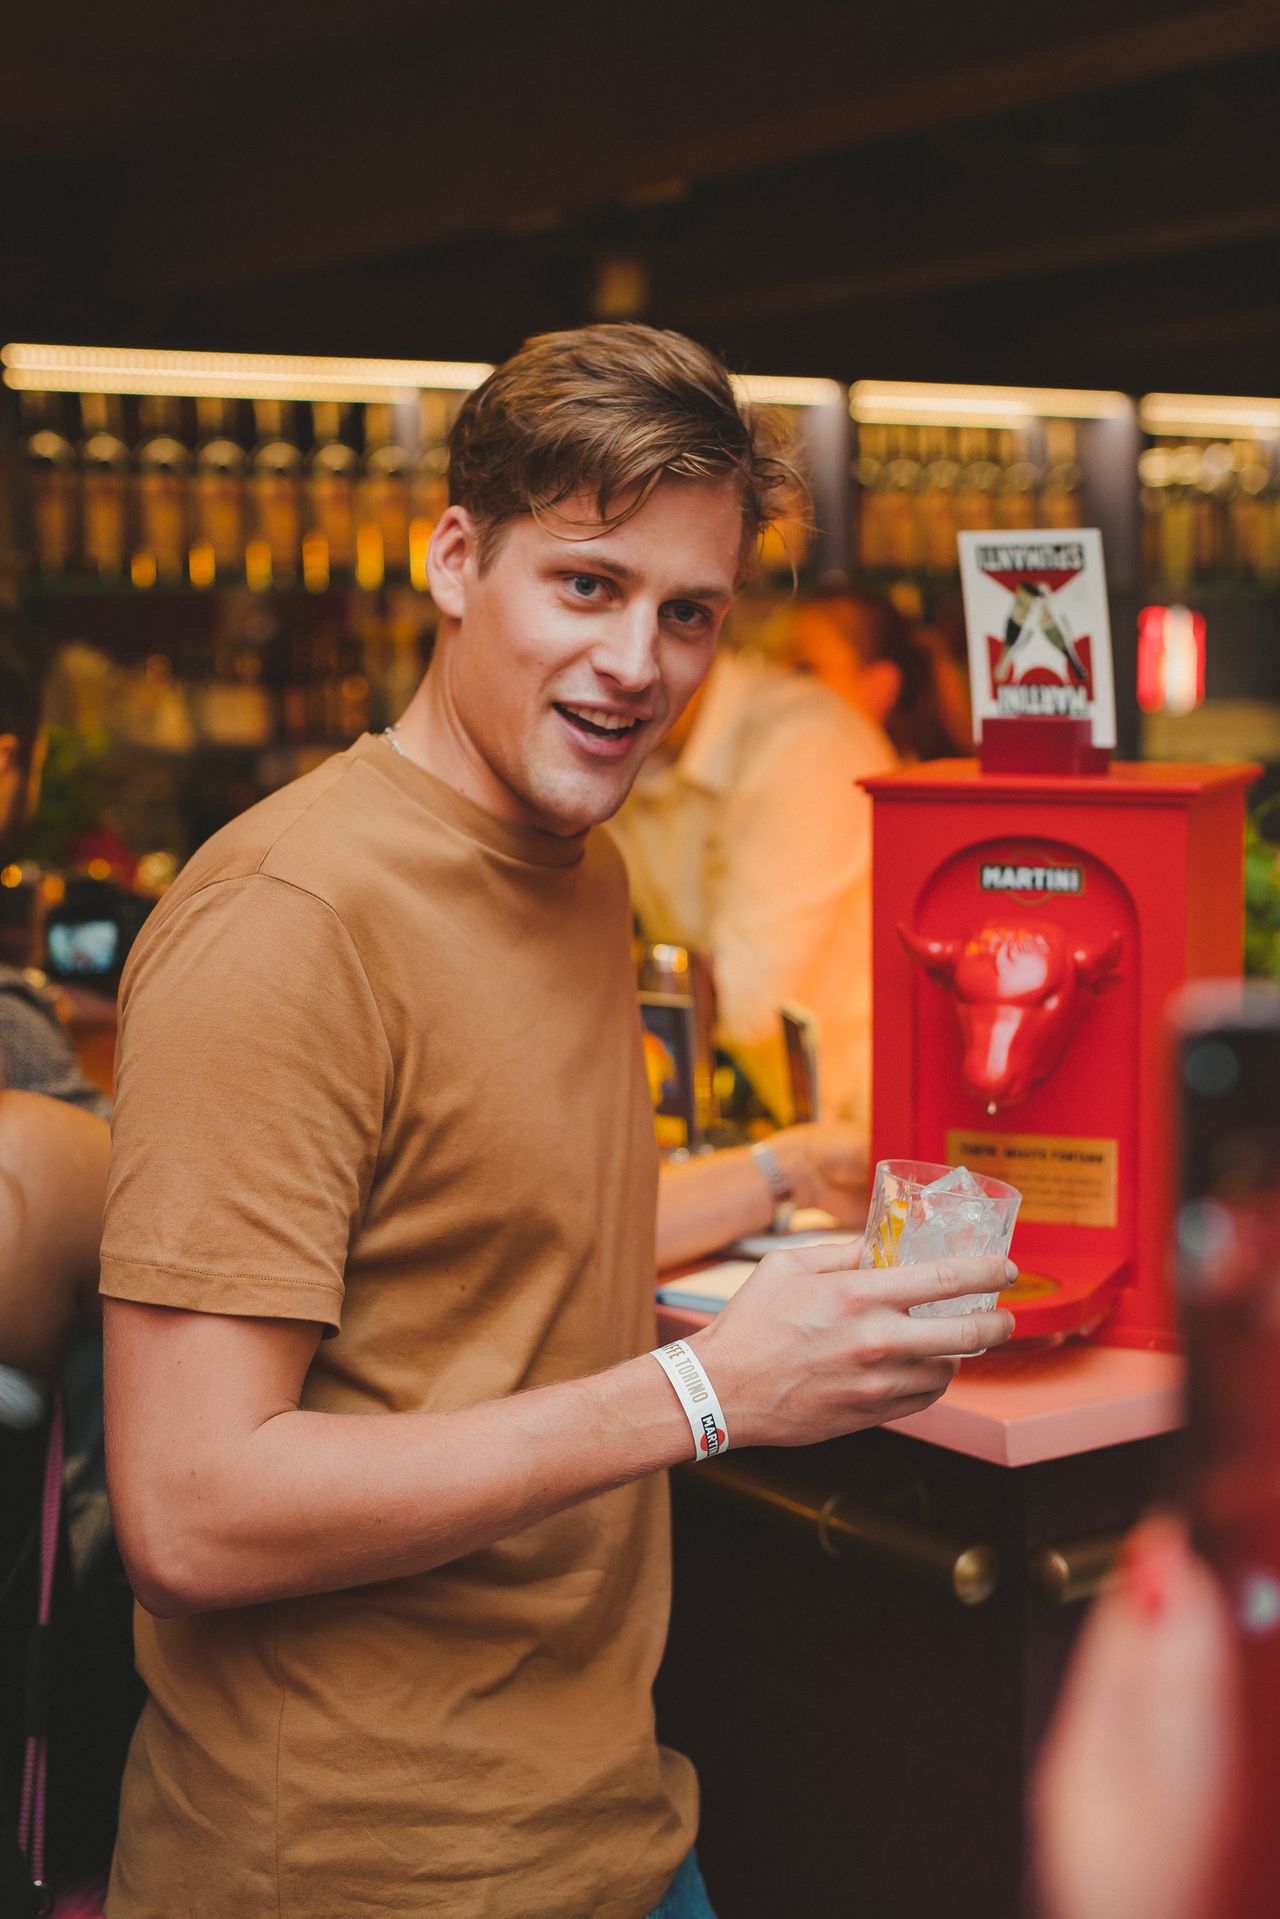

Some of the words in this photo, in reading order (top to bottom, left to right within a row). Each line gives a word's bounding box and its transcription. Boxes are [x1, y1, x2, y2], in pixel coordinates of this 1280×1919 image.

[981, 865, 1080, 892] MARTINI
[675, 1357, 709, 1403] TORINO
[702, 1413, 720, 1456] MARTIN
